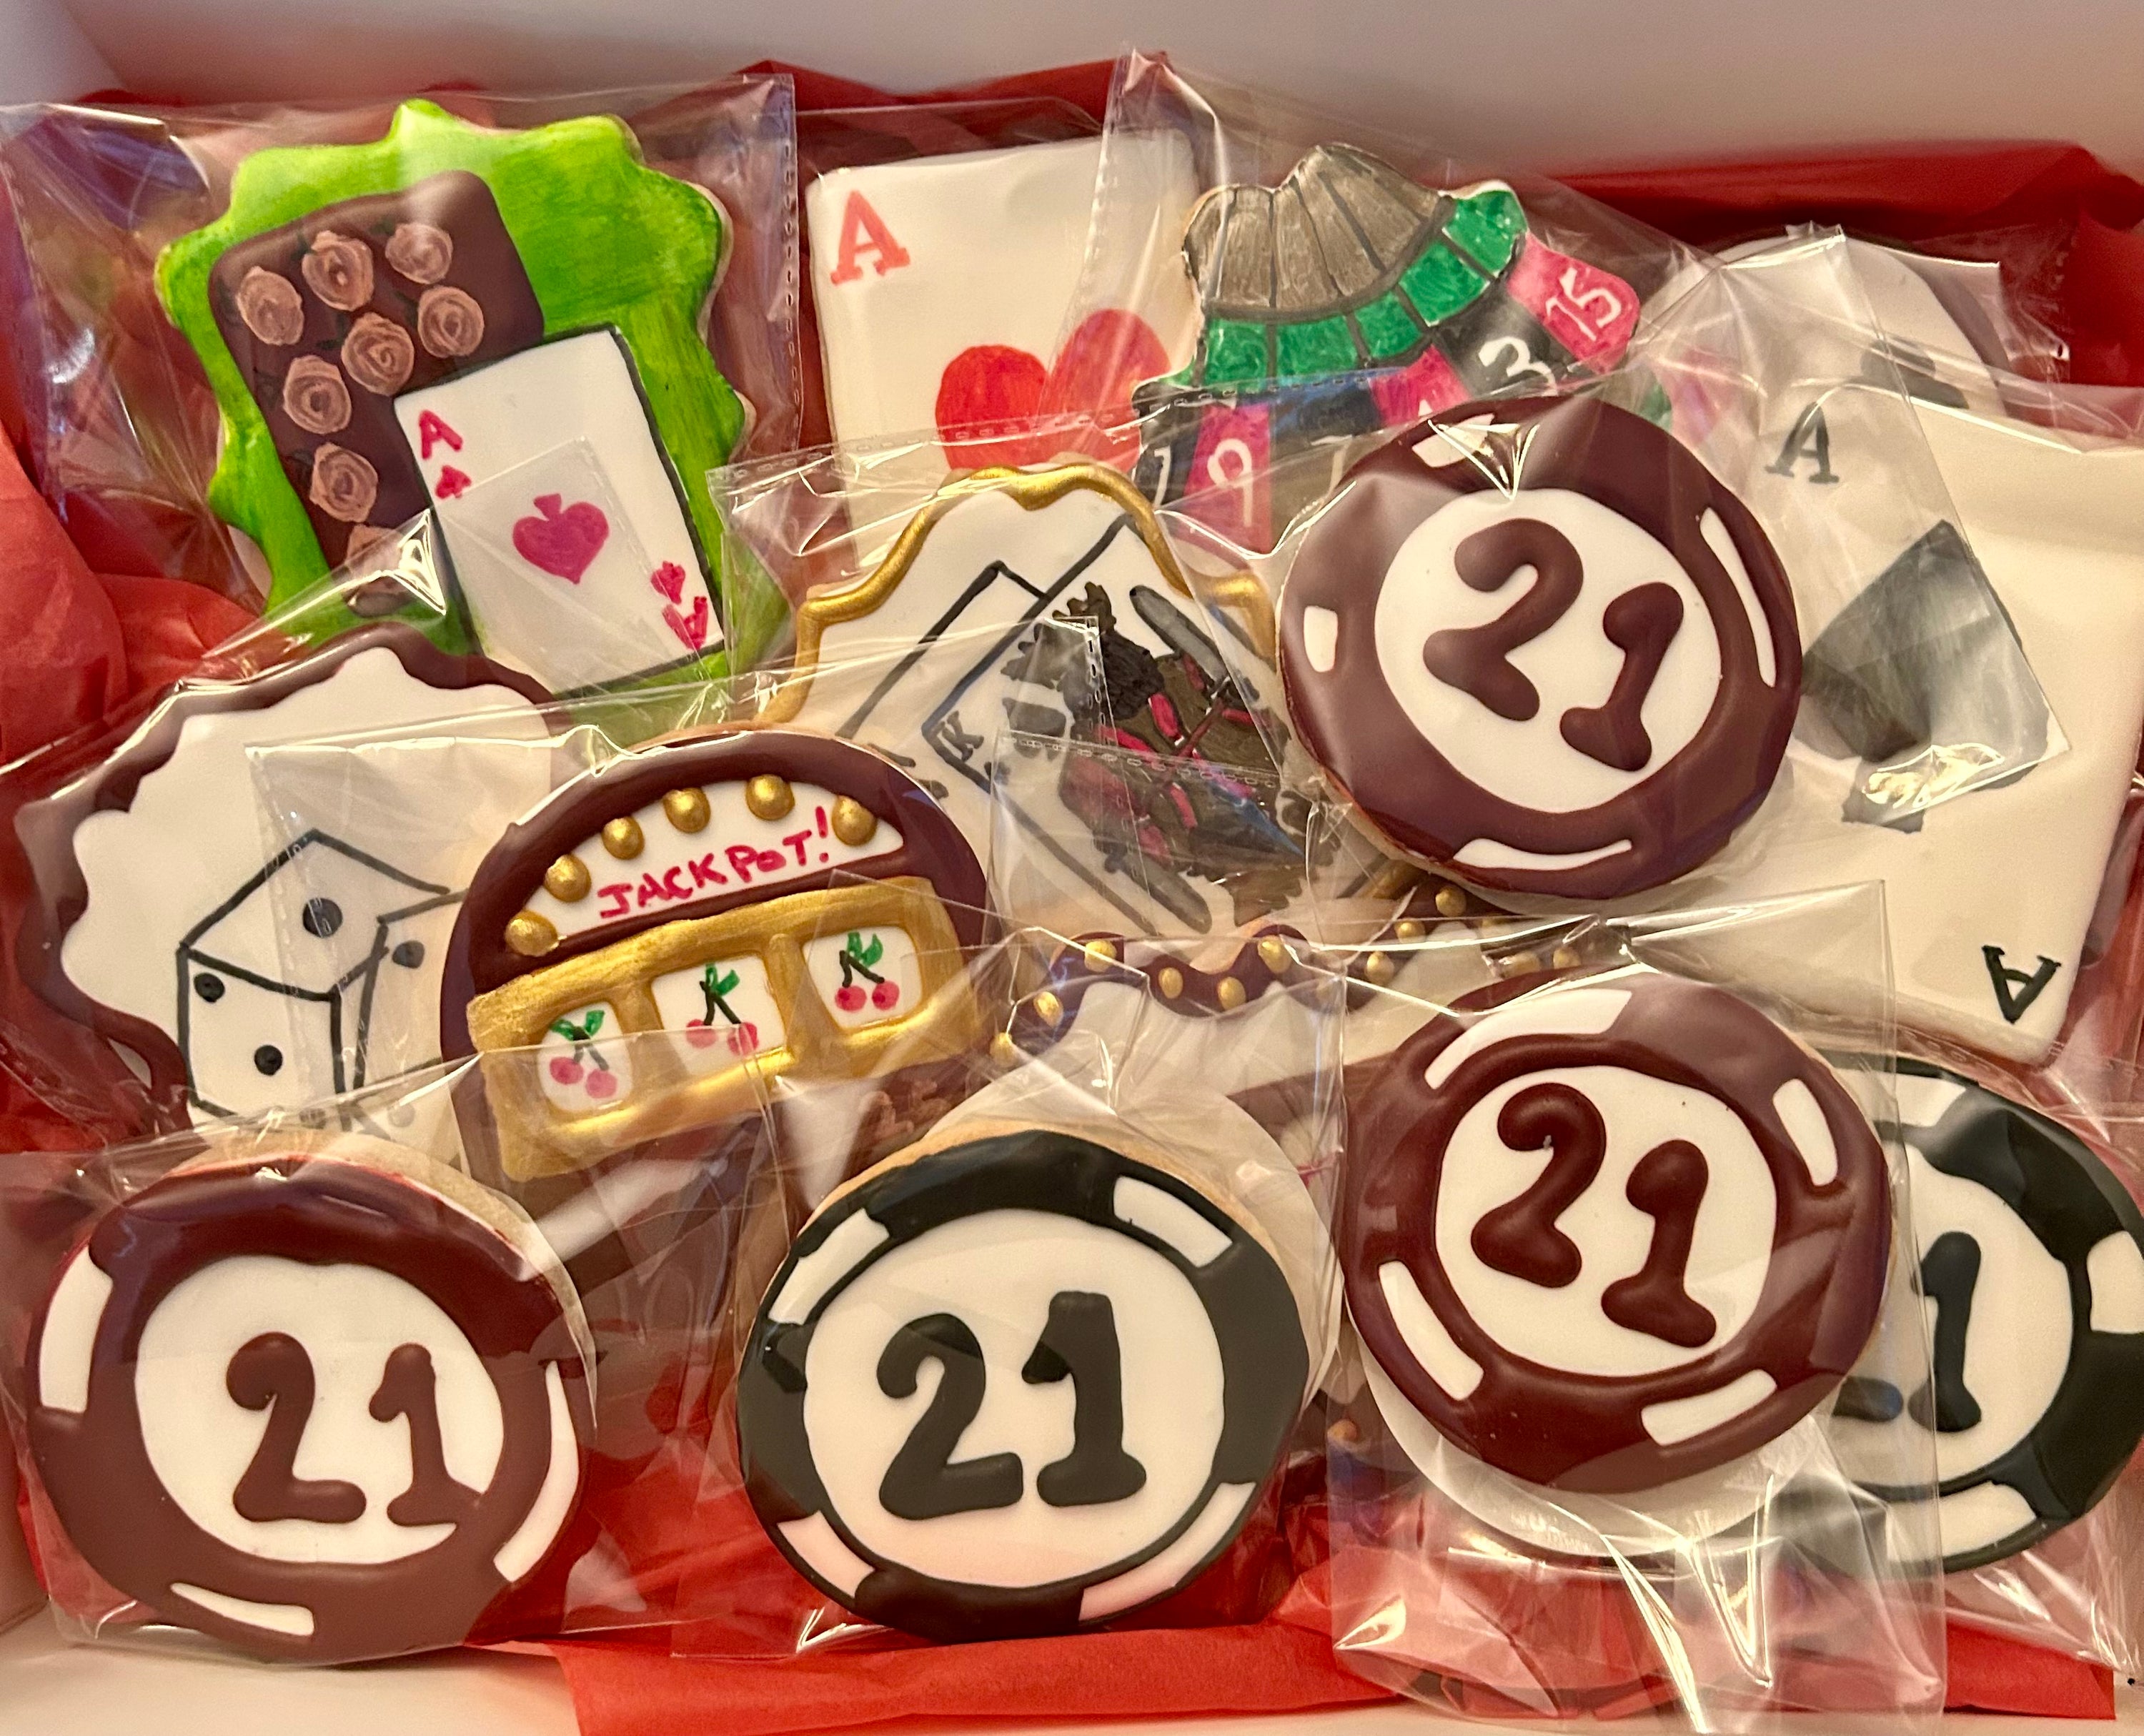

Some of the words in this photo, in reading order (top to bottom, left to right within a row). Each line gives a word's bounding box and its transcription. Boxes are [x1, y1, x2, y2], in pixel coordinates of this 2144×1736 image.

[830, 190, 910, 285] A
[1545, 267, 1622, 342] 15
[1478, 336, 1559, 397] 3
[419, 410, 463, 460] A
[1765, 400, 1840, 485] A
[1207, 438, 1253, 527] 9
[662, 596, 708, 650] A
[1423, 517, 1684, 772] 21
[597, 805, 828, 919] JACKPOT!
[1981, 944, 2061, 1024] A
[1470, 1082, 1717, 1348] 21
[226, 1331, 482, 1527] 21
[876, 1290, 1147, 1521] 21
